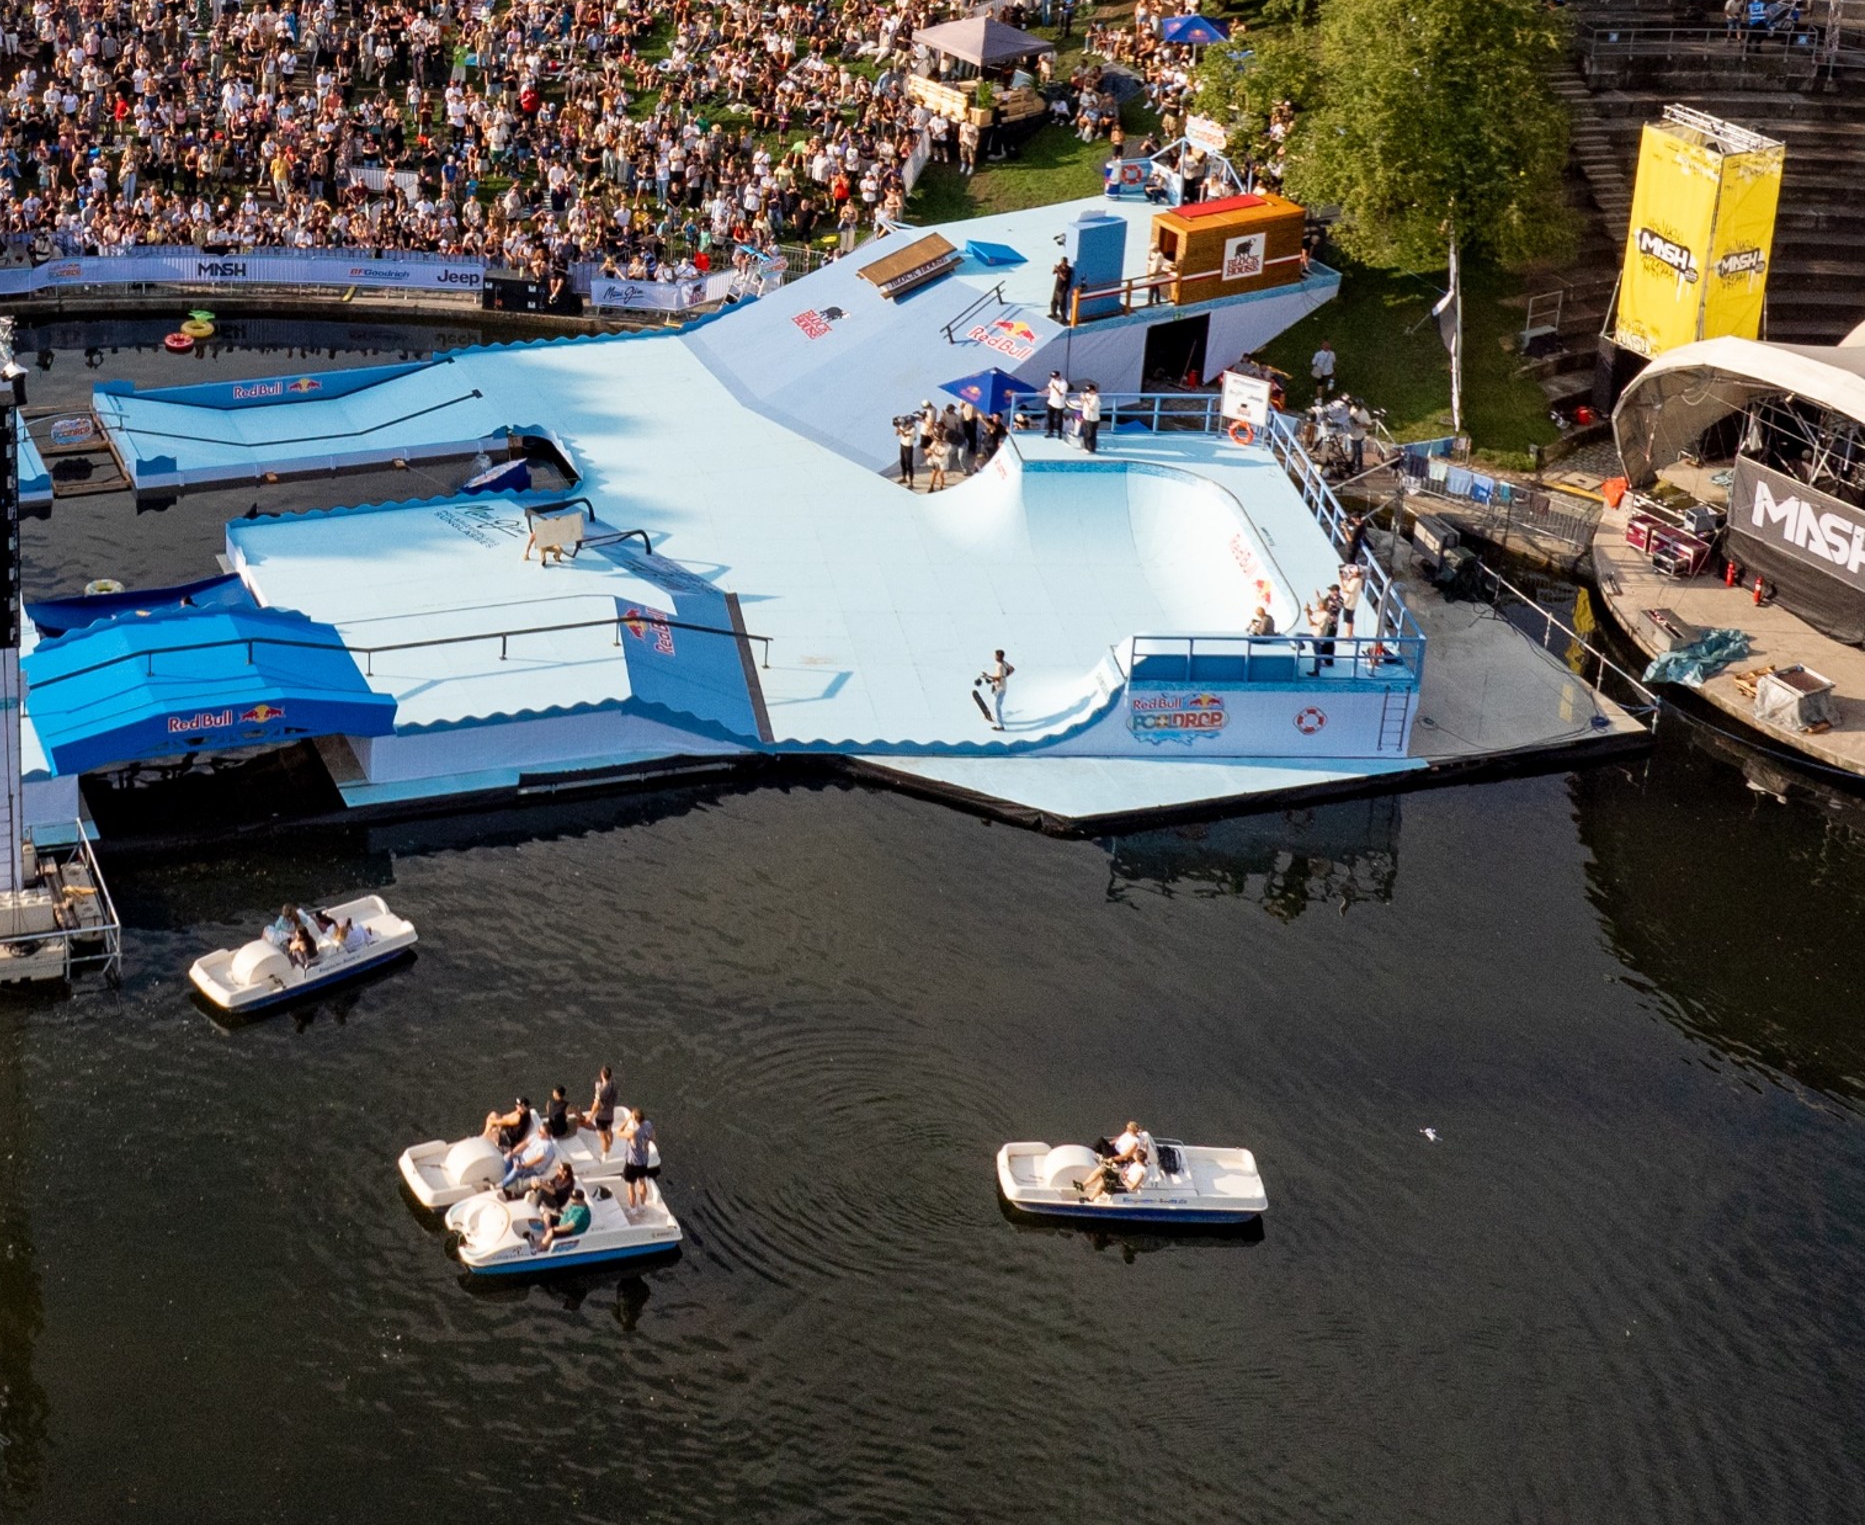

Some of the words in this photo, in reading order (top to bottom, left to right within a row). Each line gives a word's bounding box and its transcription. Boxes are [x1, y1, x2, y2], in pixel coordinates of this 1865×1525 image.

[1640, 232, 1689, 269] MASH
[197, 262, 247, 277] MASH
[1721, 250, 1758, 273] MASH
[349, 268, 410, 280] BFGoodrich
[437, 269, 480, 287] Jeep
[968, 326, 1003, 347] Red
[999, 338, 1033, 360] Bull
[233, 384, 259, 399] Red
[259, 381, 282, 396] Bull
[1133, 698, 1156, 710] Red
[1158, 697, 1182, 708] Bull
[168, 714, 200, 733] Red
[201, 710, 233, 729] Bull
